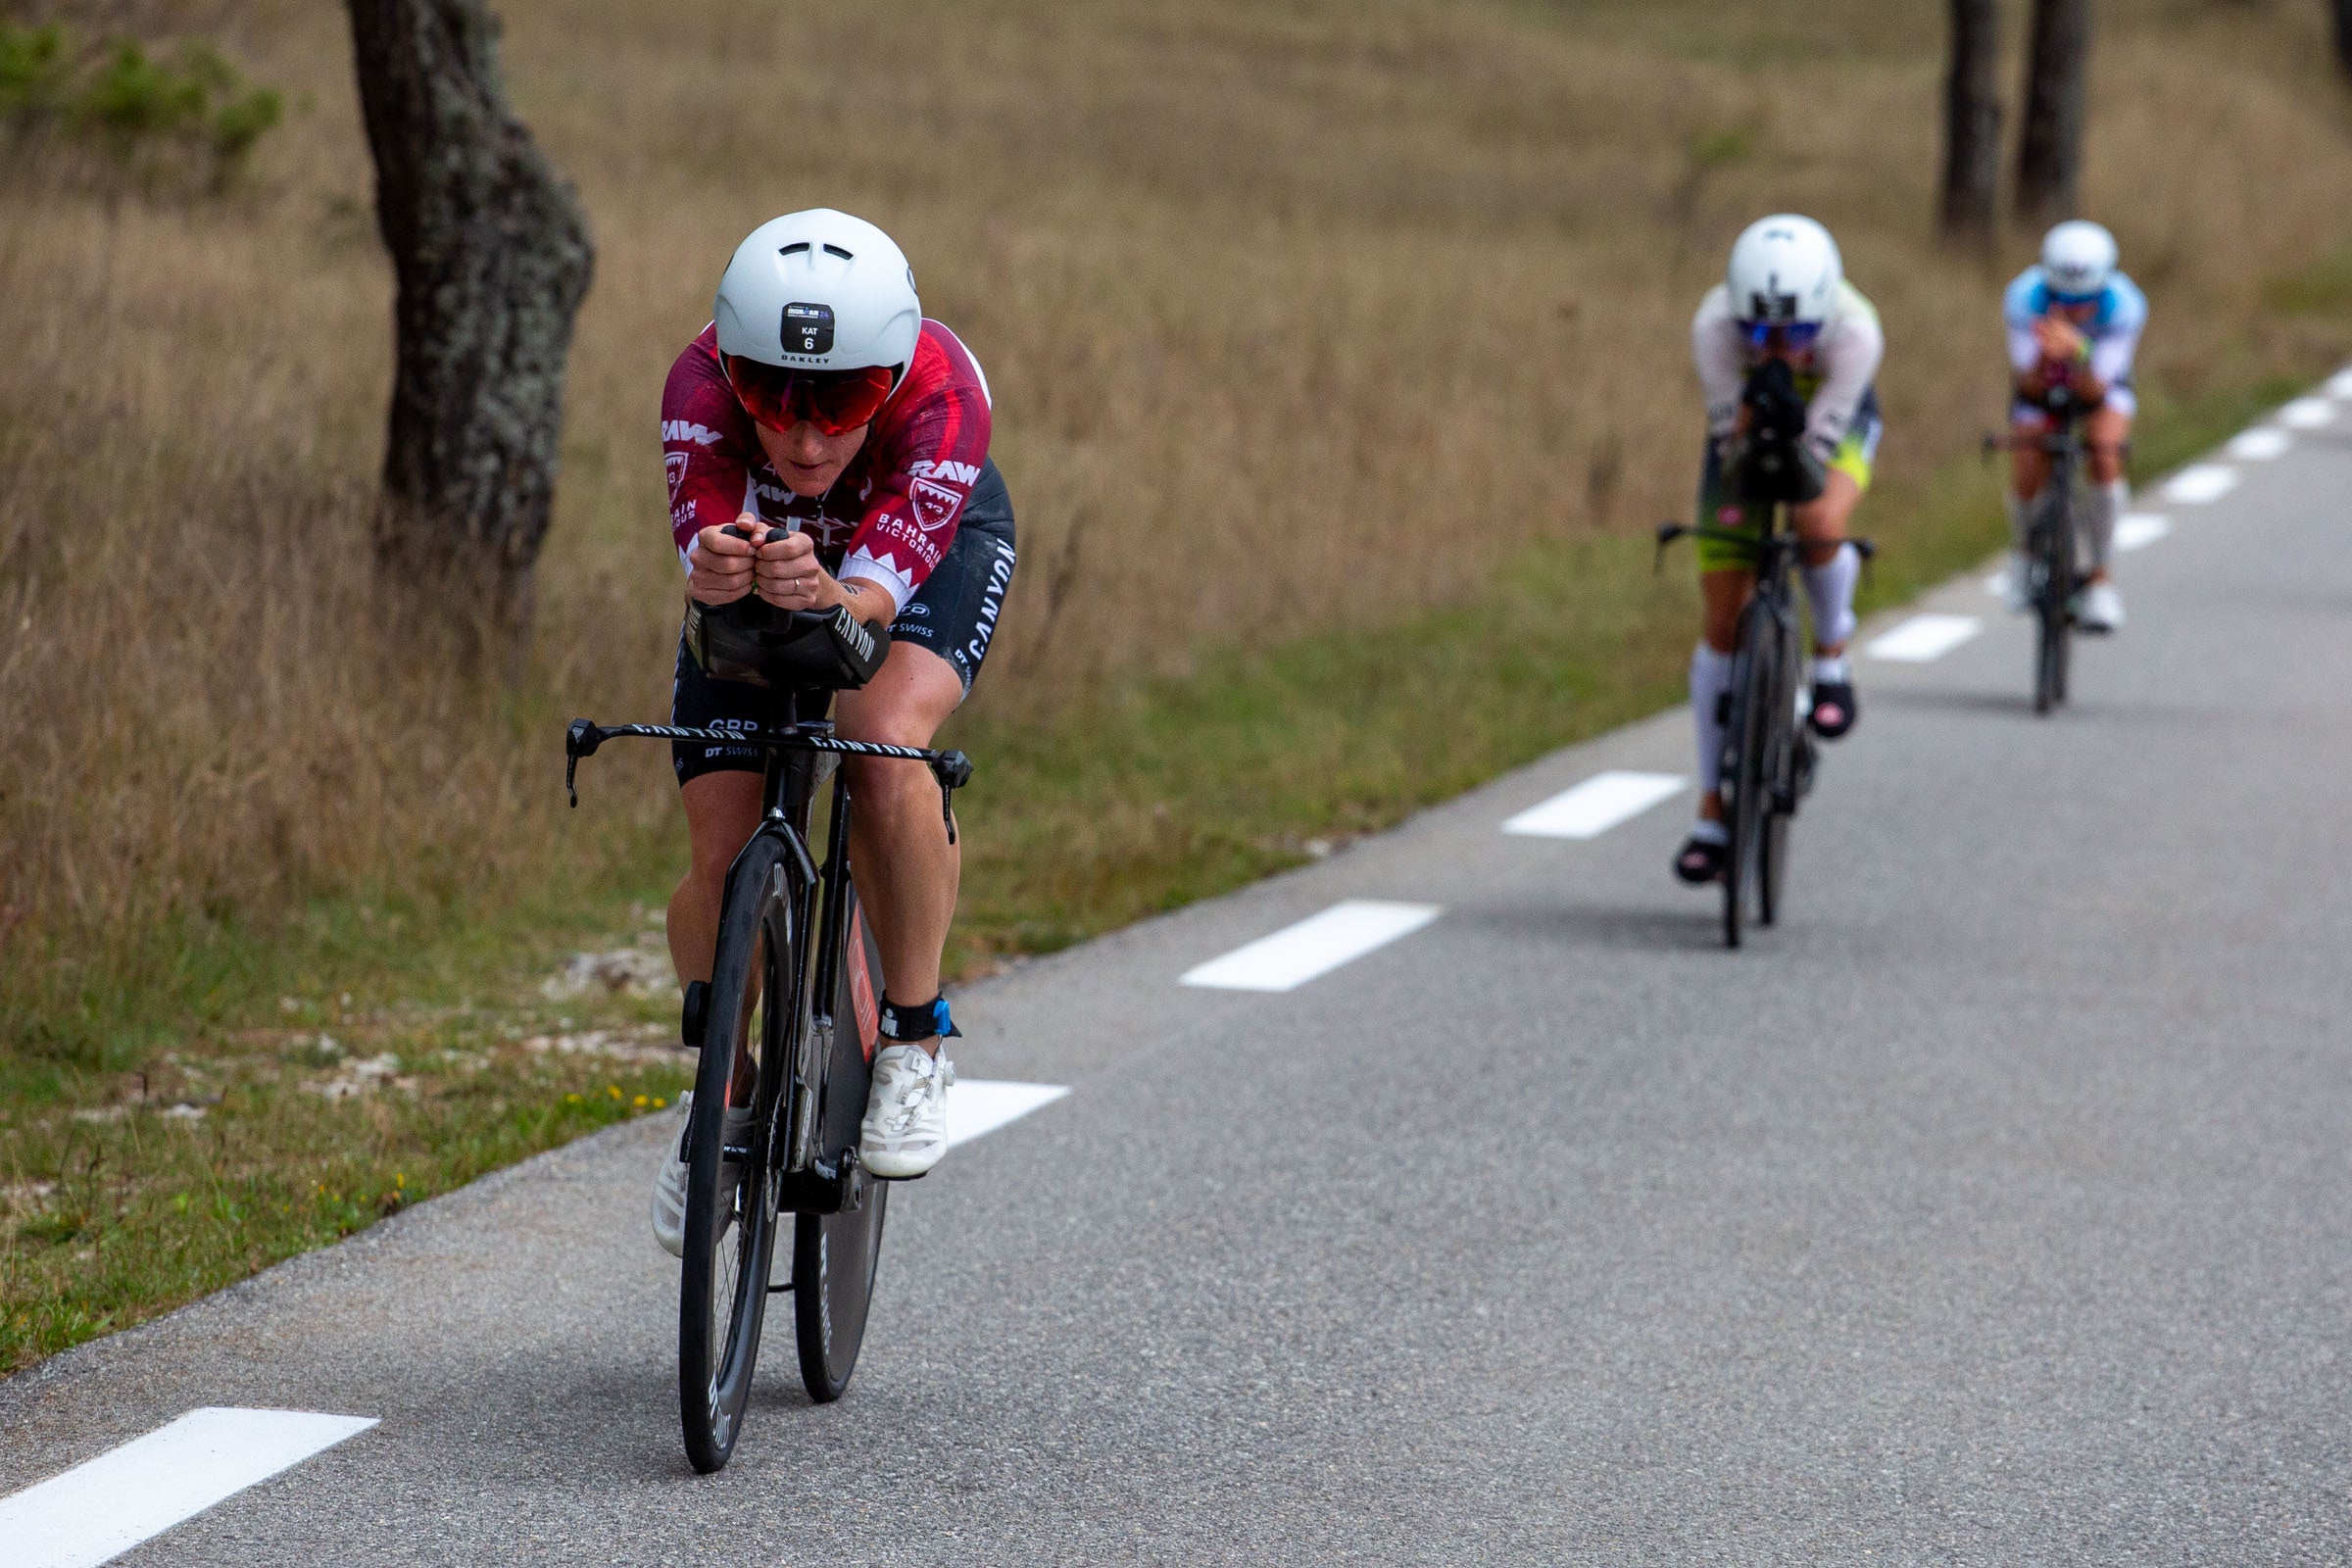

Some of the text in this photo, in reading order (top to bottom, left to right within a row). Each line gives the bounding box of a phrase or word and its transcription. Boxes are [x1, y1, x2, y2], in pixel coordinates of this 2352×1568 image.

[802, 326, 818, 335] KAT
[804, 337, 814, 350] 6
[781, 354, 830, 364] OAKLEY
[907, 460, 981, 487] RAW
[968, 537, 1016, 662] CANYON
[834, 607, 875, 662] CANYON
[899, 622, 934, 638] SWISS
[632, 722, 748, 741] CANYON
[705, 746, 760, 759] DT SWISS
[810, 736, 924, 759] CANYON
